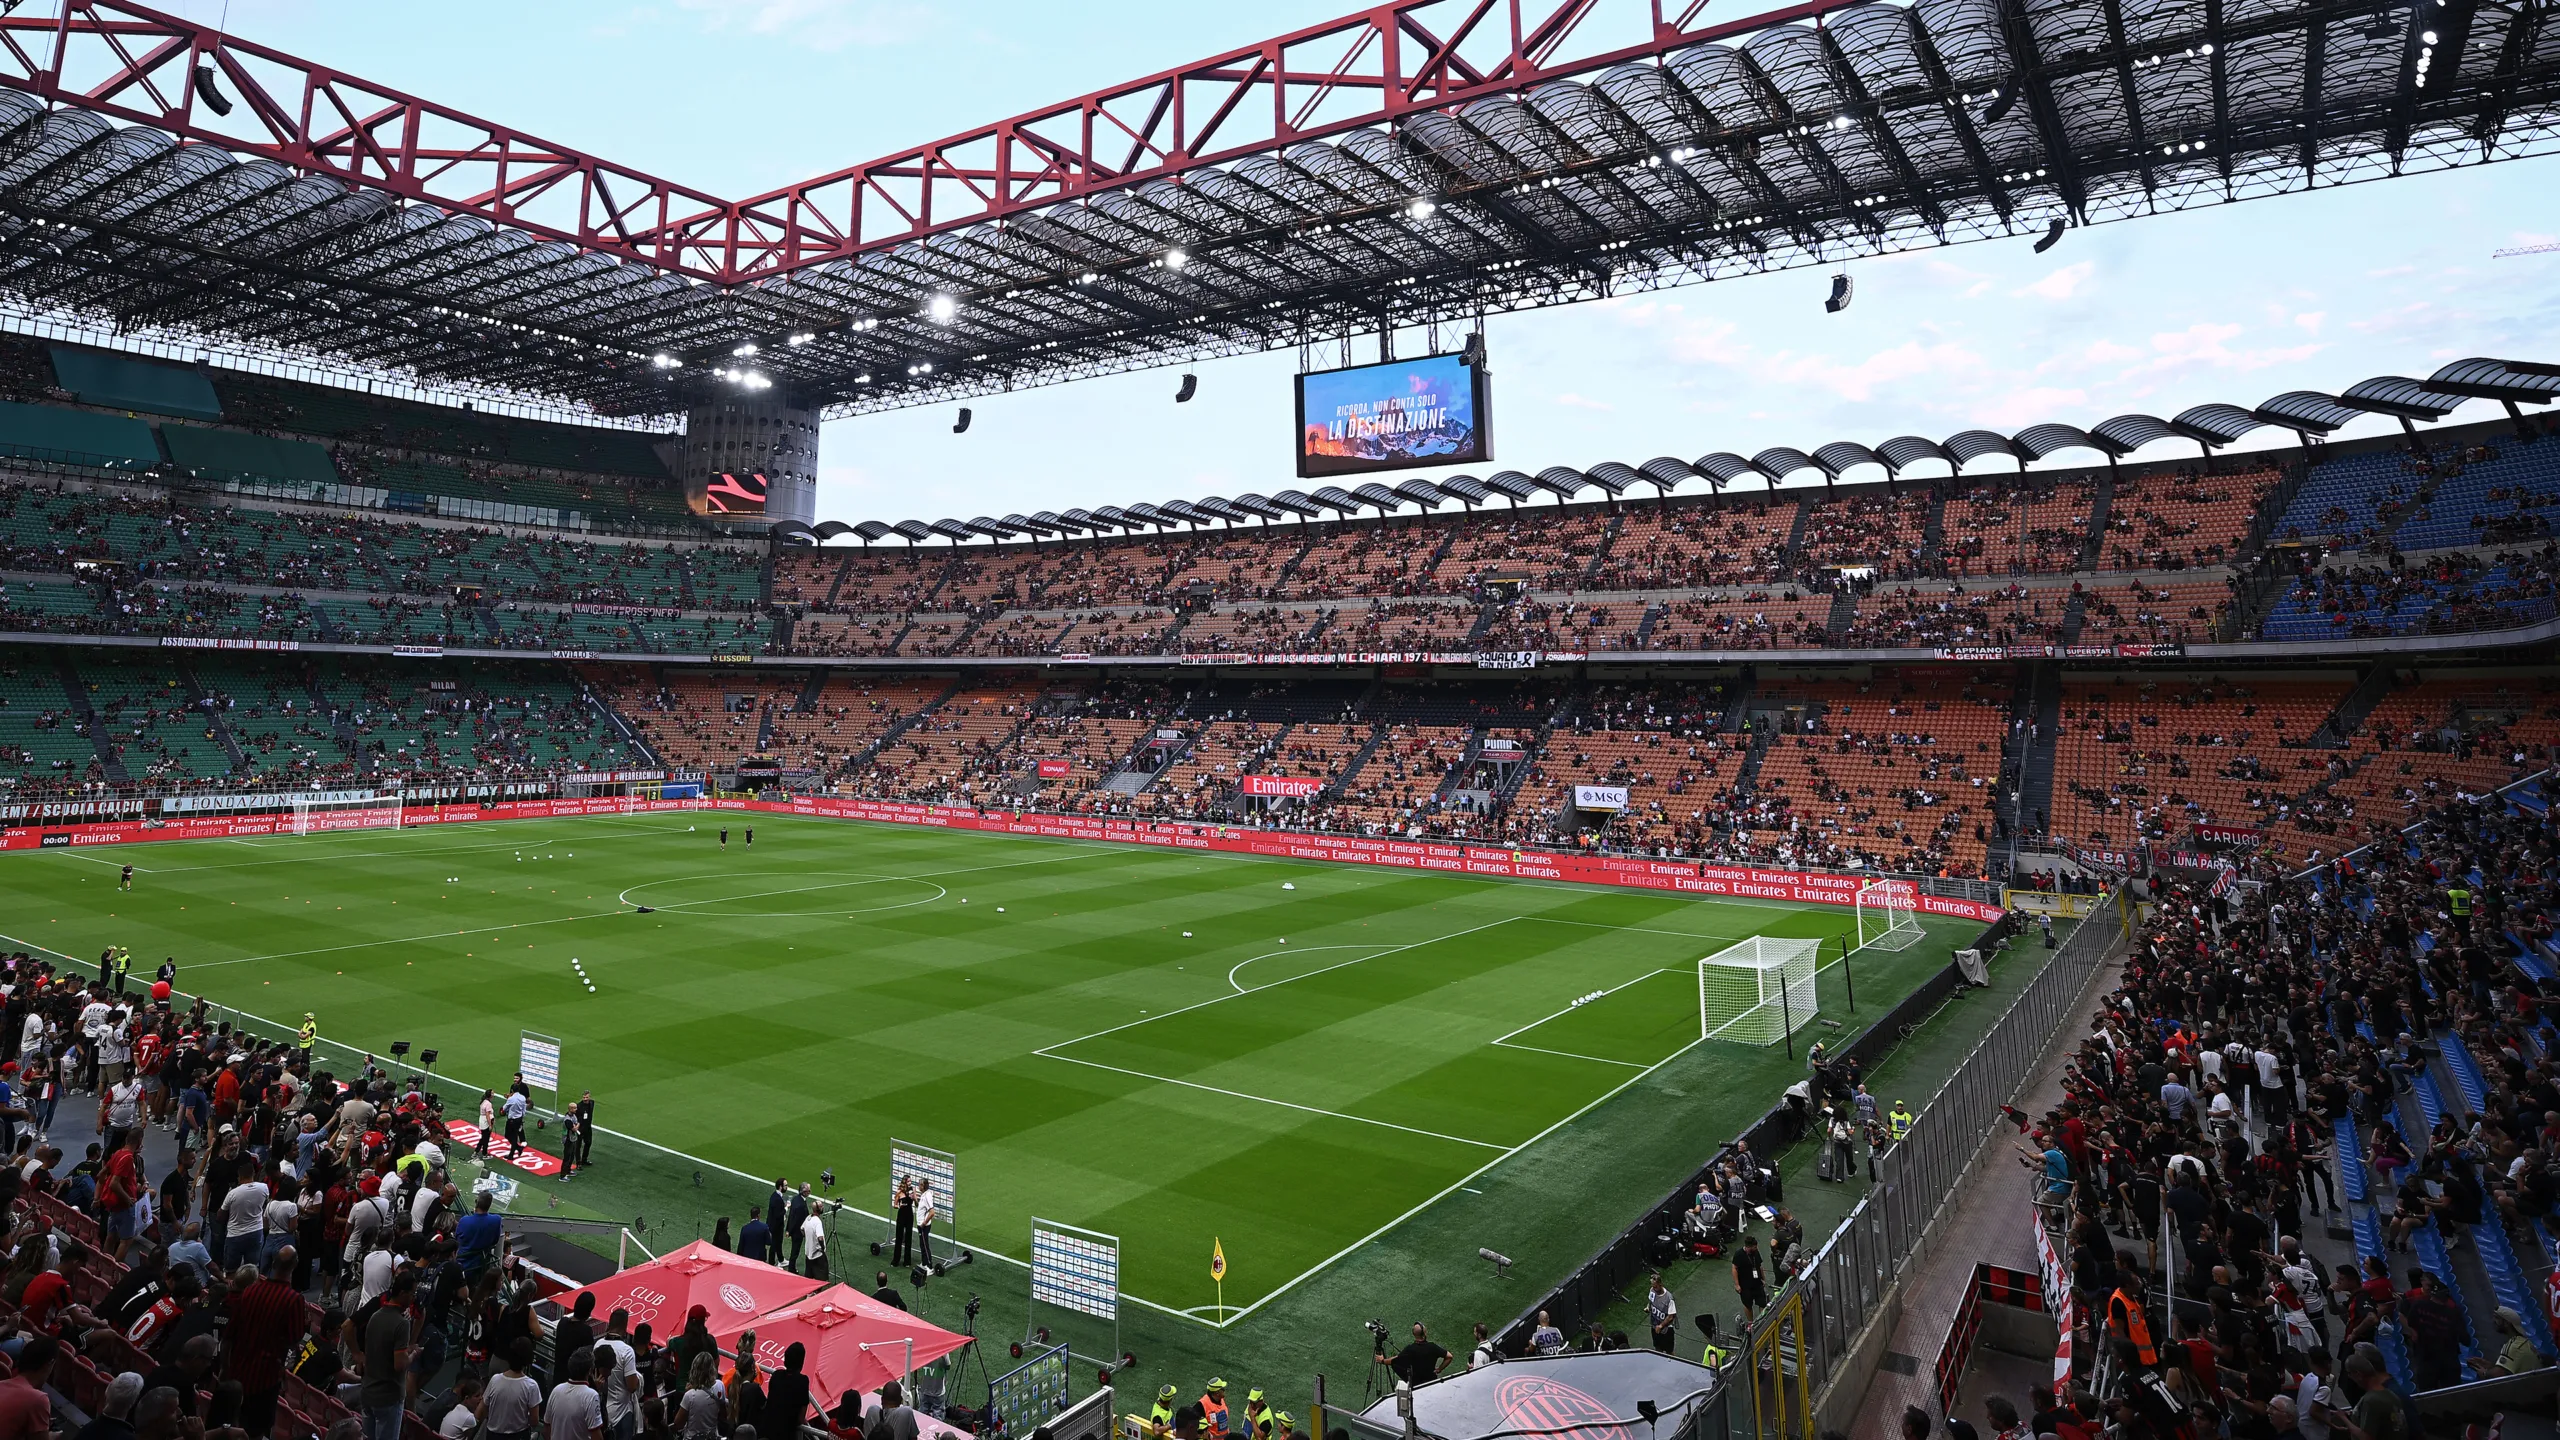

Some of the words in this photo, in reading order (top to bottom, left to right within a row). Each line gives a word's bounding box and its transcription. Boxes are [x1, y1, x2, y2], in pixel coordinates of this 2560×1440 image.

[1336, 403, 1370, 417] RICORDA,
[1373, 400, 1388, 412] NON
[1391, 396, 1414, 410] CONTA
[1417, 394, 1437, 407] SOLO
[1328, 420, 1342, 440] LA
[1348, 407, 1447, 438] DESTINAZIONE
[574, 603, 613, 615] NAVIGLIO
[161, 636, 218, 648] ASSOCIAZIONE
[220, 639, 254, 649] ITALIANA
[256, 640, 278, 650] MILAN
[280, 641, 299, 650] CLUB
[1404, 652, 1428, 662] 1973
[1480, 652, 1518, 661] SQUALO
[1934, 648, 1954, 659] M.C.
[430, 681, 456, 690] MILAN
[1156, 730, 1178, 738] PUMA
[1484, 738, 1512, 750] PUMA
[614, 770, 666, 782] #WEAREACMILAN
[674, 772, 706, 780] DESIO
[396, 787, 460, 800] FAMILY
[467, 785, 499, 797] DAY
[506, 783, 548, 795] AIMC
[1252, 778, 1313, 796] Emirates
[192, 794, 296, 810] FONDAZIONE
[304, 792, 352, 802] MILAN
[1594, 792, 1622, 802] MSC
[43, 802, 95, 817] SCUOLA
[98, 800, 143, 814] CALCIO
[43, 836, 68, 844] 00:00
[72, 832, 121, 844] Emirates
[180, 826, 222, 838] Emirates
[228, 824, 270, 834] Emirates
[275, 820, 316, 832] Emirates
[320, 818, 359, 829] Emirates
[363, 816, 400, 826] Emirates
[404, 814, 440, 824] Emirates
[444, 812, 478, 821] Emirates
[770, 804, 792, 812] Emirates
[794, 804, 816, 814] Emirates
[818, 807, 840, 816] Emirates
[842, 809, 866, 818] Emirates
[868, 811, 892, 820] Emirates
[894, 814, 920, 823] Emirates
[922, 816, 948, 826] Emirates
[979, 820, 1006, 831] Emirates
[1009, 822, 1037, 833] Emirates
[1040, 824, 1069, 836] Emirates
[1072, 827, 1102, 838] Emirates
[1106, 830, 1136, 841] Emirates
[1140, 833, 1172, 844] Emirates
[1176, 836, 1209, 848] Emirates
[1278, 834, 1310, 845] Emirates
[1314, 837, 1348, 848] Emirates
[1351, 840, 1385, 852] Emirates
[1389, 842, 1424, 854] Emirates
[1470, 850, 1508, 862] Emirates
[1602, 860, 1645, 872] Emirates
[1650, 864, 1694, 876] Emirates
[1752, 872, 1800, 884] Emirates
[1806, 875, 1856, 889] Emirates
[2080, 850, 2126, 865] ALBA
[2172, 856, 2198, 868] LUNA
[2200, 858, 2225, 870] PAR
[1251, 842, 1286, 854] Emirates
[1290, 846, 1328, 858] Emirates
[1332, 850, 1370, 862] Emirates
[1375, 852, 1415, 866] Emirates
[1420, 856, 1462, 870] Emirates
[1466, 860, 1510, 874] Emirates
[1516, 864, 1561, 878] Emirates
[1620, 872, 1669, 888] Emirates
[1675, 878, 1726, 892] Emirates
[1733, 882, 1787, 898] Emirates
[1794, 888, 1850, 902] Emirates
[1924, 898, 1976, 916] Emirates
[142, 1045, 150, 1060] 7
[630, 1286, 666, 1306] CLUB
[605, 1294, 658, 1324] 1899
[1650, 1306, 1666, 1320] OTO
[1537, 1332, 1559, 1346] 303
[760, 1340, 786, 1362] CLU
[923, 1366, 935, 1377] TV
[1512, 1382, 1568, 1398] ACM
